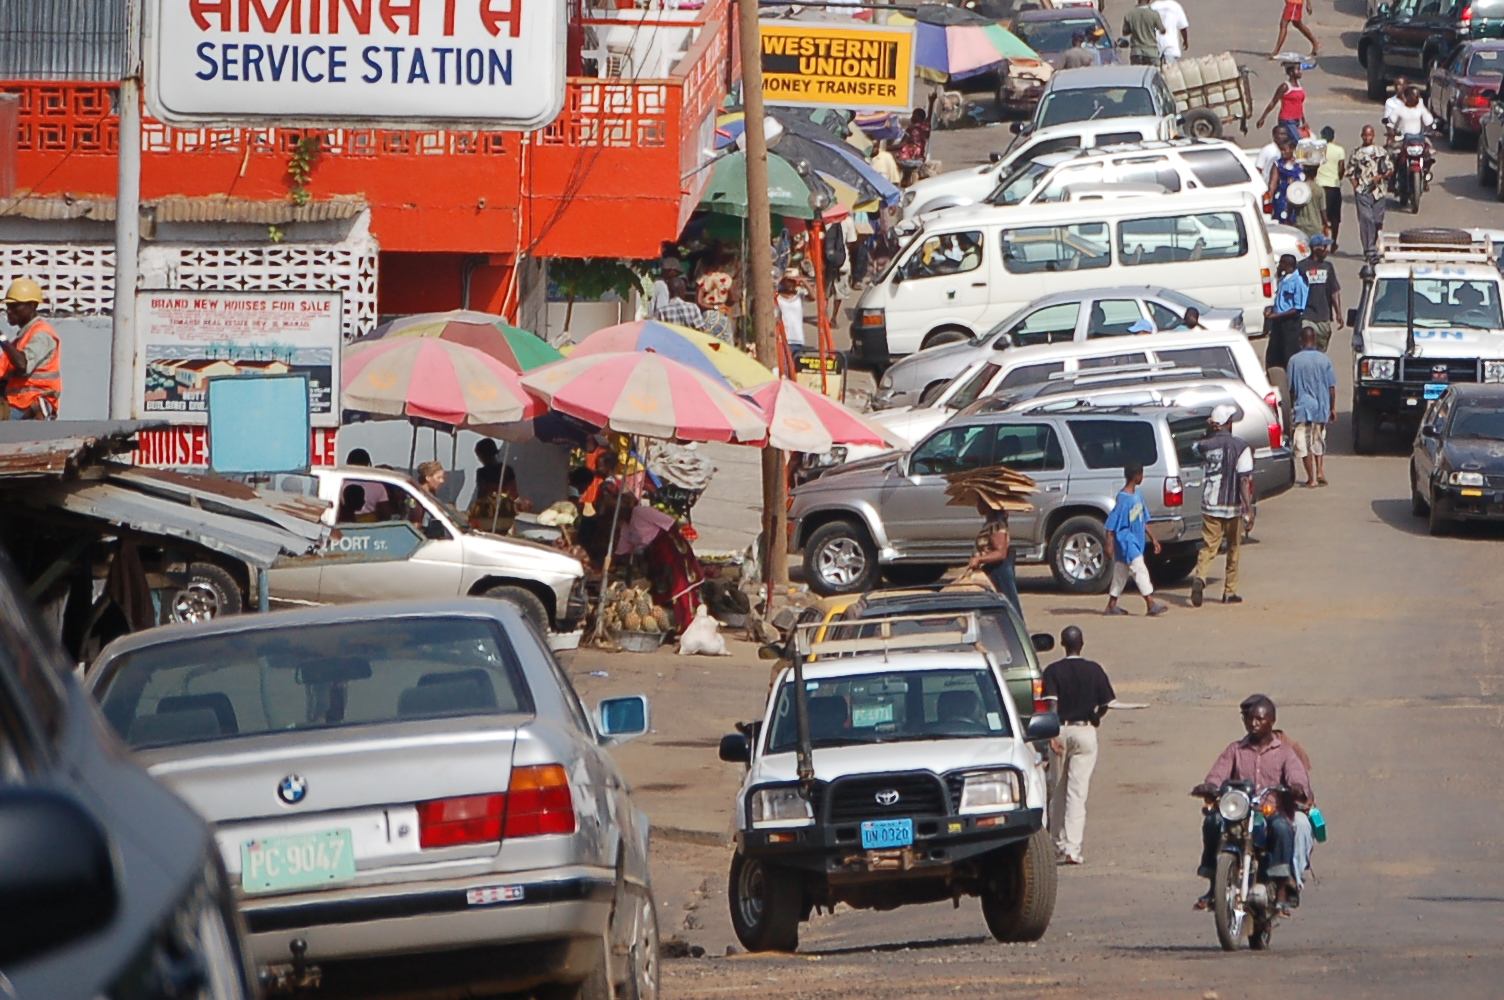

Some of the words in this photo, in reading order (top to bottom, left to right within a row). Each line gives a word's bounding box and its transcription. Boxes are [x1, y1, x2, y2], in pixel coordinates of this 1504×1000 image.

[763, 36, 879, 59] WESTERN
[195, 41, 347, 83] SERVICE
[361, 45, 513, 86] STATION
[799, 57, 879, 78] UNION
[816, 80, 897, 97] TRANSFER
[150, 299, 189, 310] BRAND
[193, 299, 219, 310] NEW
[224, 300, 267, 311] HOUSES
[271, 300, 296, 311] FOR
[300, 300, 332, 312] SALE
[1414, 331, 1464, 340] UN
[311, 427, 337, 466] LE
[373, 541, 388, 551] ST.
